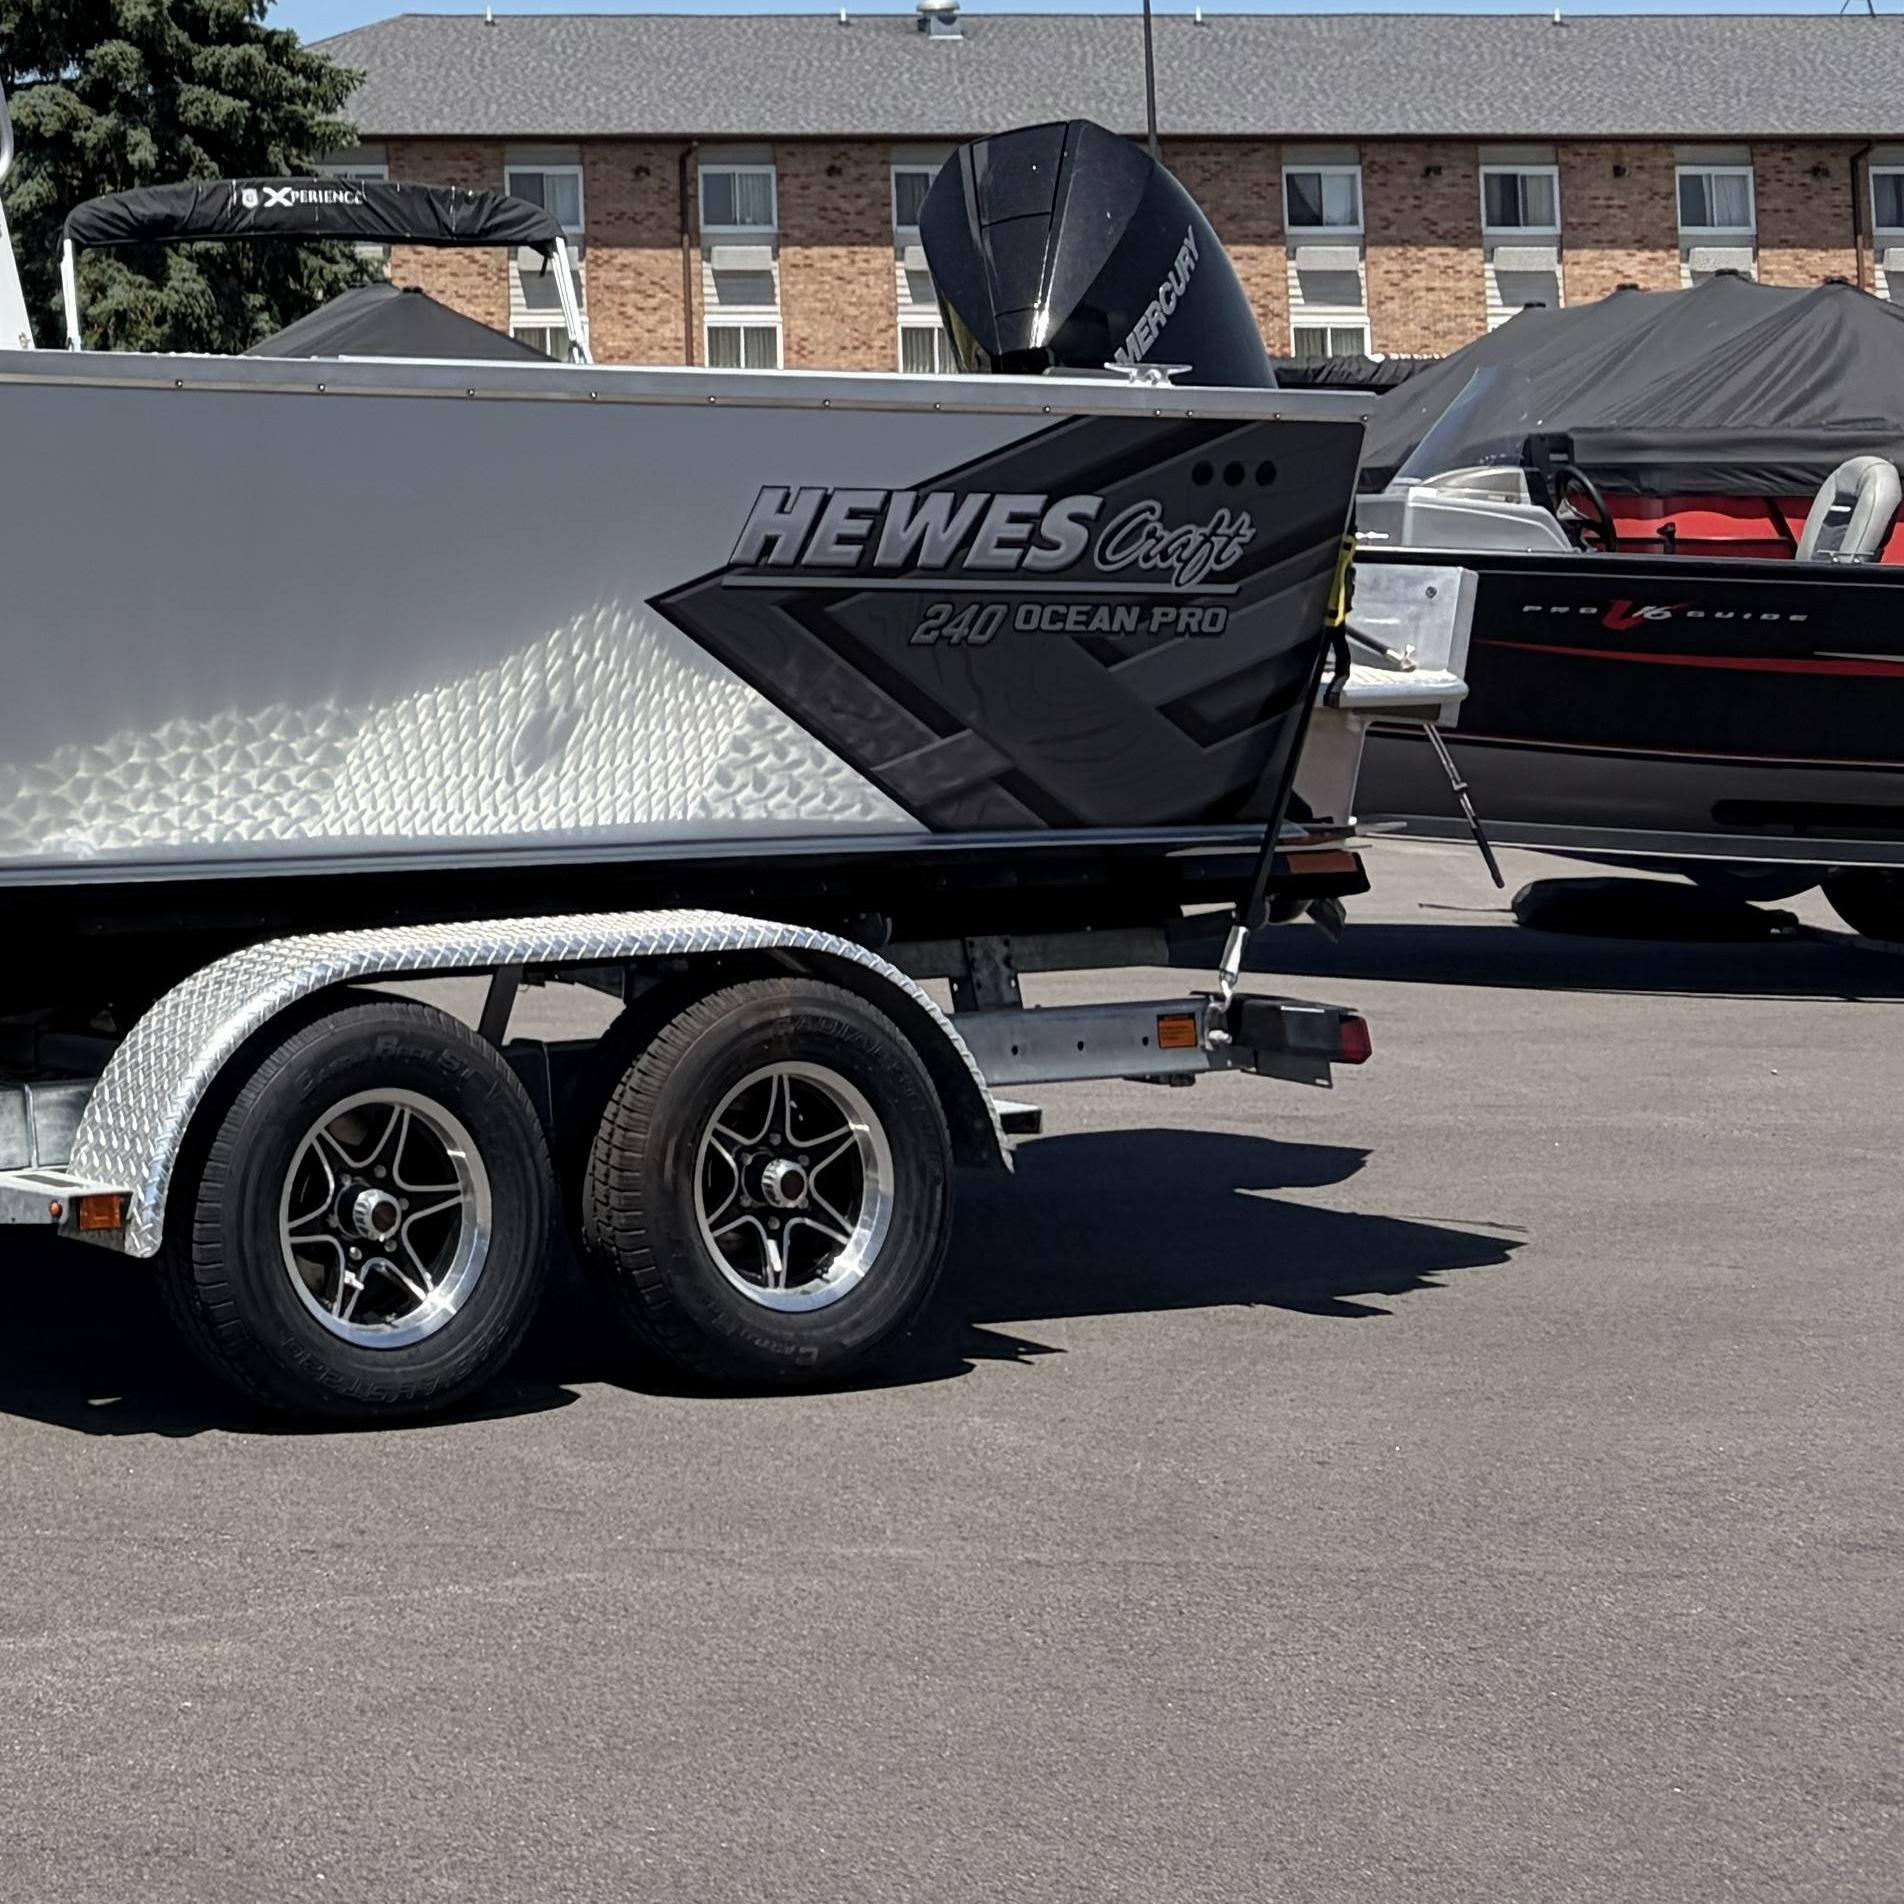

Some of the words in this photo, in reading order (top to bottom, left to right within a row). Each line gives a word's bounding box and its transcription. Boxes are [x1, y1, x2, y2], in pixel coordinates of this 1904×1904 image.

[1114, 225, 1201, 365] MERCURY
[729, 485, 1105, 570] HEWES
[1094, 499, 1257, 588] Craft
[909, 602, 1003, 646] 240
[1014, 603, 1140, 634] OCEAN
[1148, 605, 1228, 635] PRO
[1522, 605, 1598, 614] PRO
[1686, 610, 1809, 621] GUIDE
